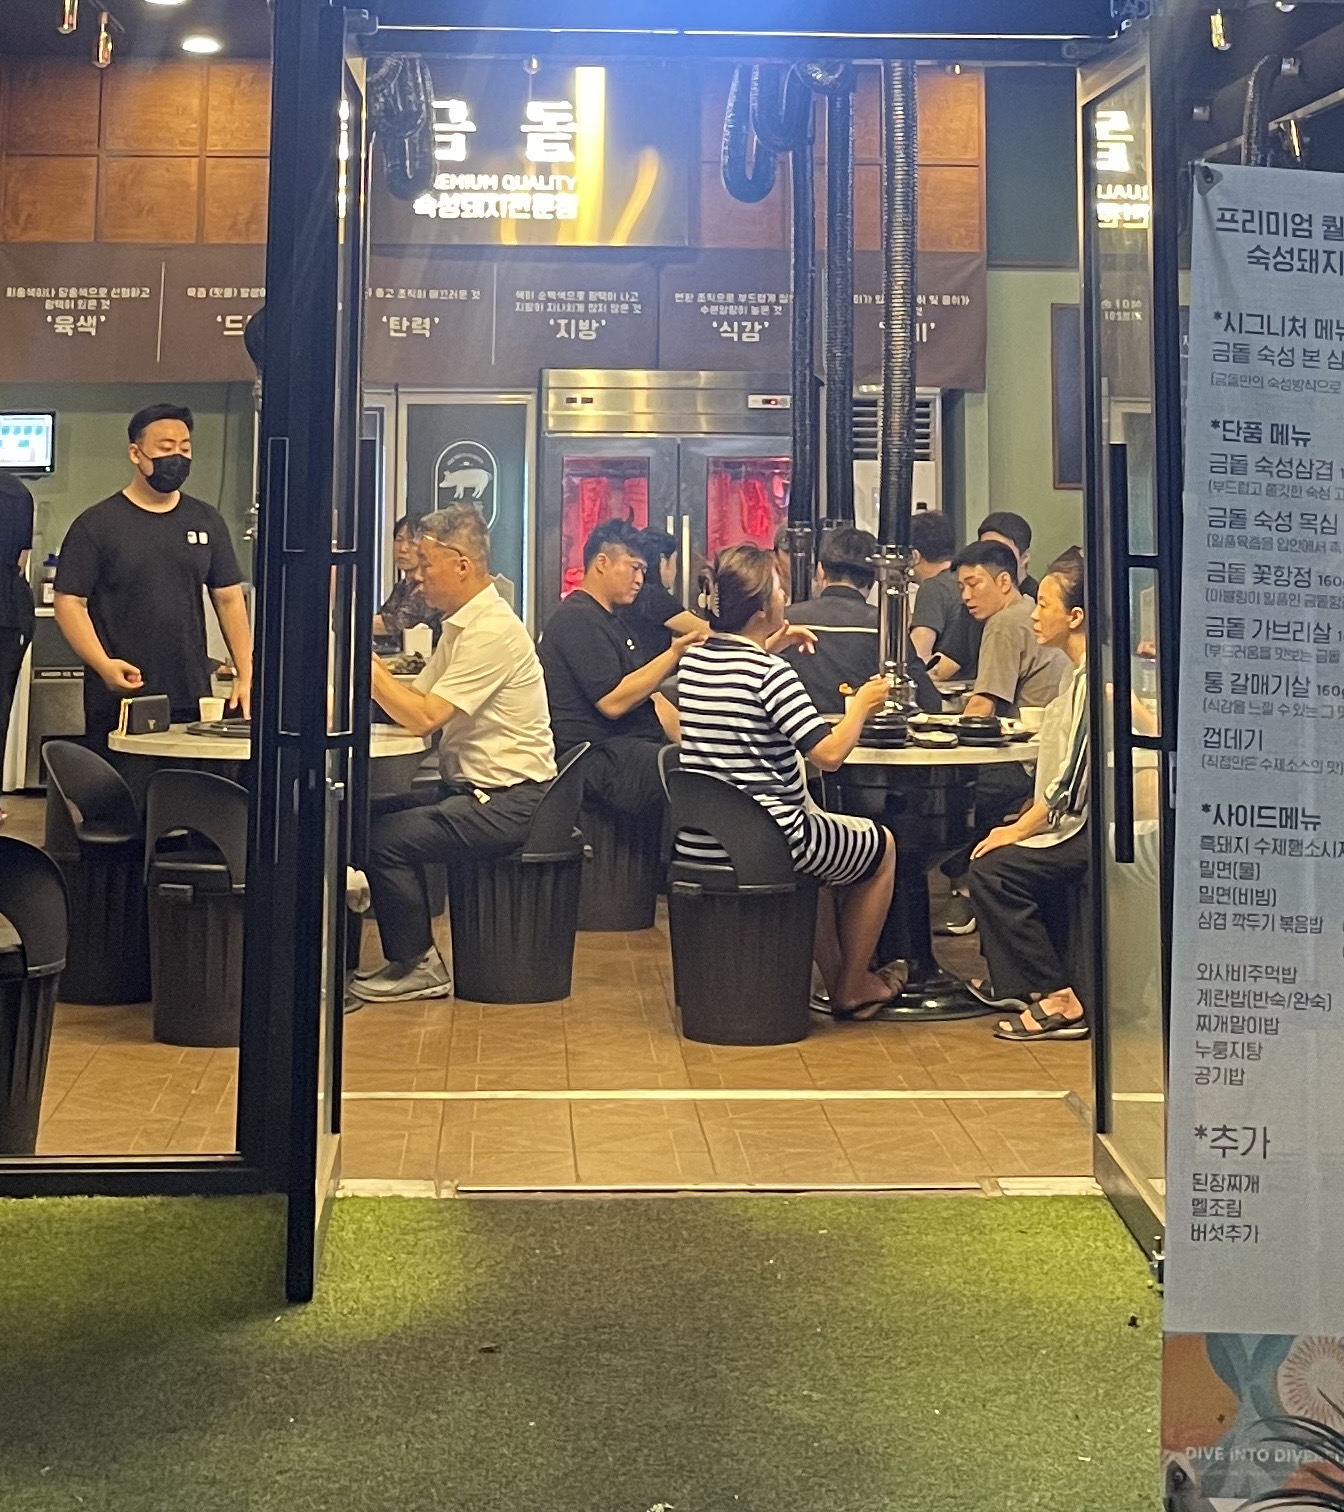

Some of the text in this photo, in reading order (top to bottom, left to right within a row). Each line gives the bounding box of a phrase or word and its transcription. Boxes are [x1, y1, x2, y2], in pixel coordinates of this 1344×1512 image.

[1215, 206, 1314, 240] 프리미엄
[1257, 344, 1296, 369] 숙성
[1301, 347, 1323, 370] 본
[1269, 422, 1312, 448] 메뉴
[1254, 455, 1335, 482] 숙성삼겹
[1253, 509, 1293, 533] 숙성
[1299, 512, 1338, 536] 목심
[1251, 563, 1312, 588] 꽃항정
[1251, 618, 1332, 644] 가브리살
[1204, 671, 1224, 695] 통
[1230, 673, 1311, 699] 갈매기살
[1203, 726, 1263, 751] 껍데기
[1199, 860, 1261, 881] 밀면(물)
[1199, 885, 1277, 907] 밀면(비빔)
[1198, 911, 1227, 931] 삼겹
[1232, 913, 1275, 932] 깍두기
[1279, 915, 1324, 934] 볶음밥
[1196, 962, 1298, 985] 와사비주먹밥
[1195, 989, 1333, 1012] 계란밥(반숙/완숙)
[1195, 1014, 1280, 1037] 찌개말이밥
[1194, 1040, 1263, 1062] 누룽지탕
[1193, 1065, 1245, 1087] 공기밥
[1192, 1172, 1261, 1195] 된장찌개
[1191, 1223, 1260, 1244] 버섯추가
[1184, 1446, 1225, 1462] DIVE
[1229, 1447, 1270, 1463] INTO
